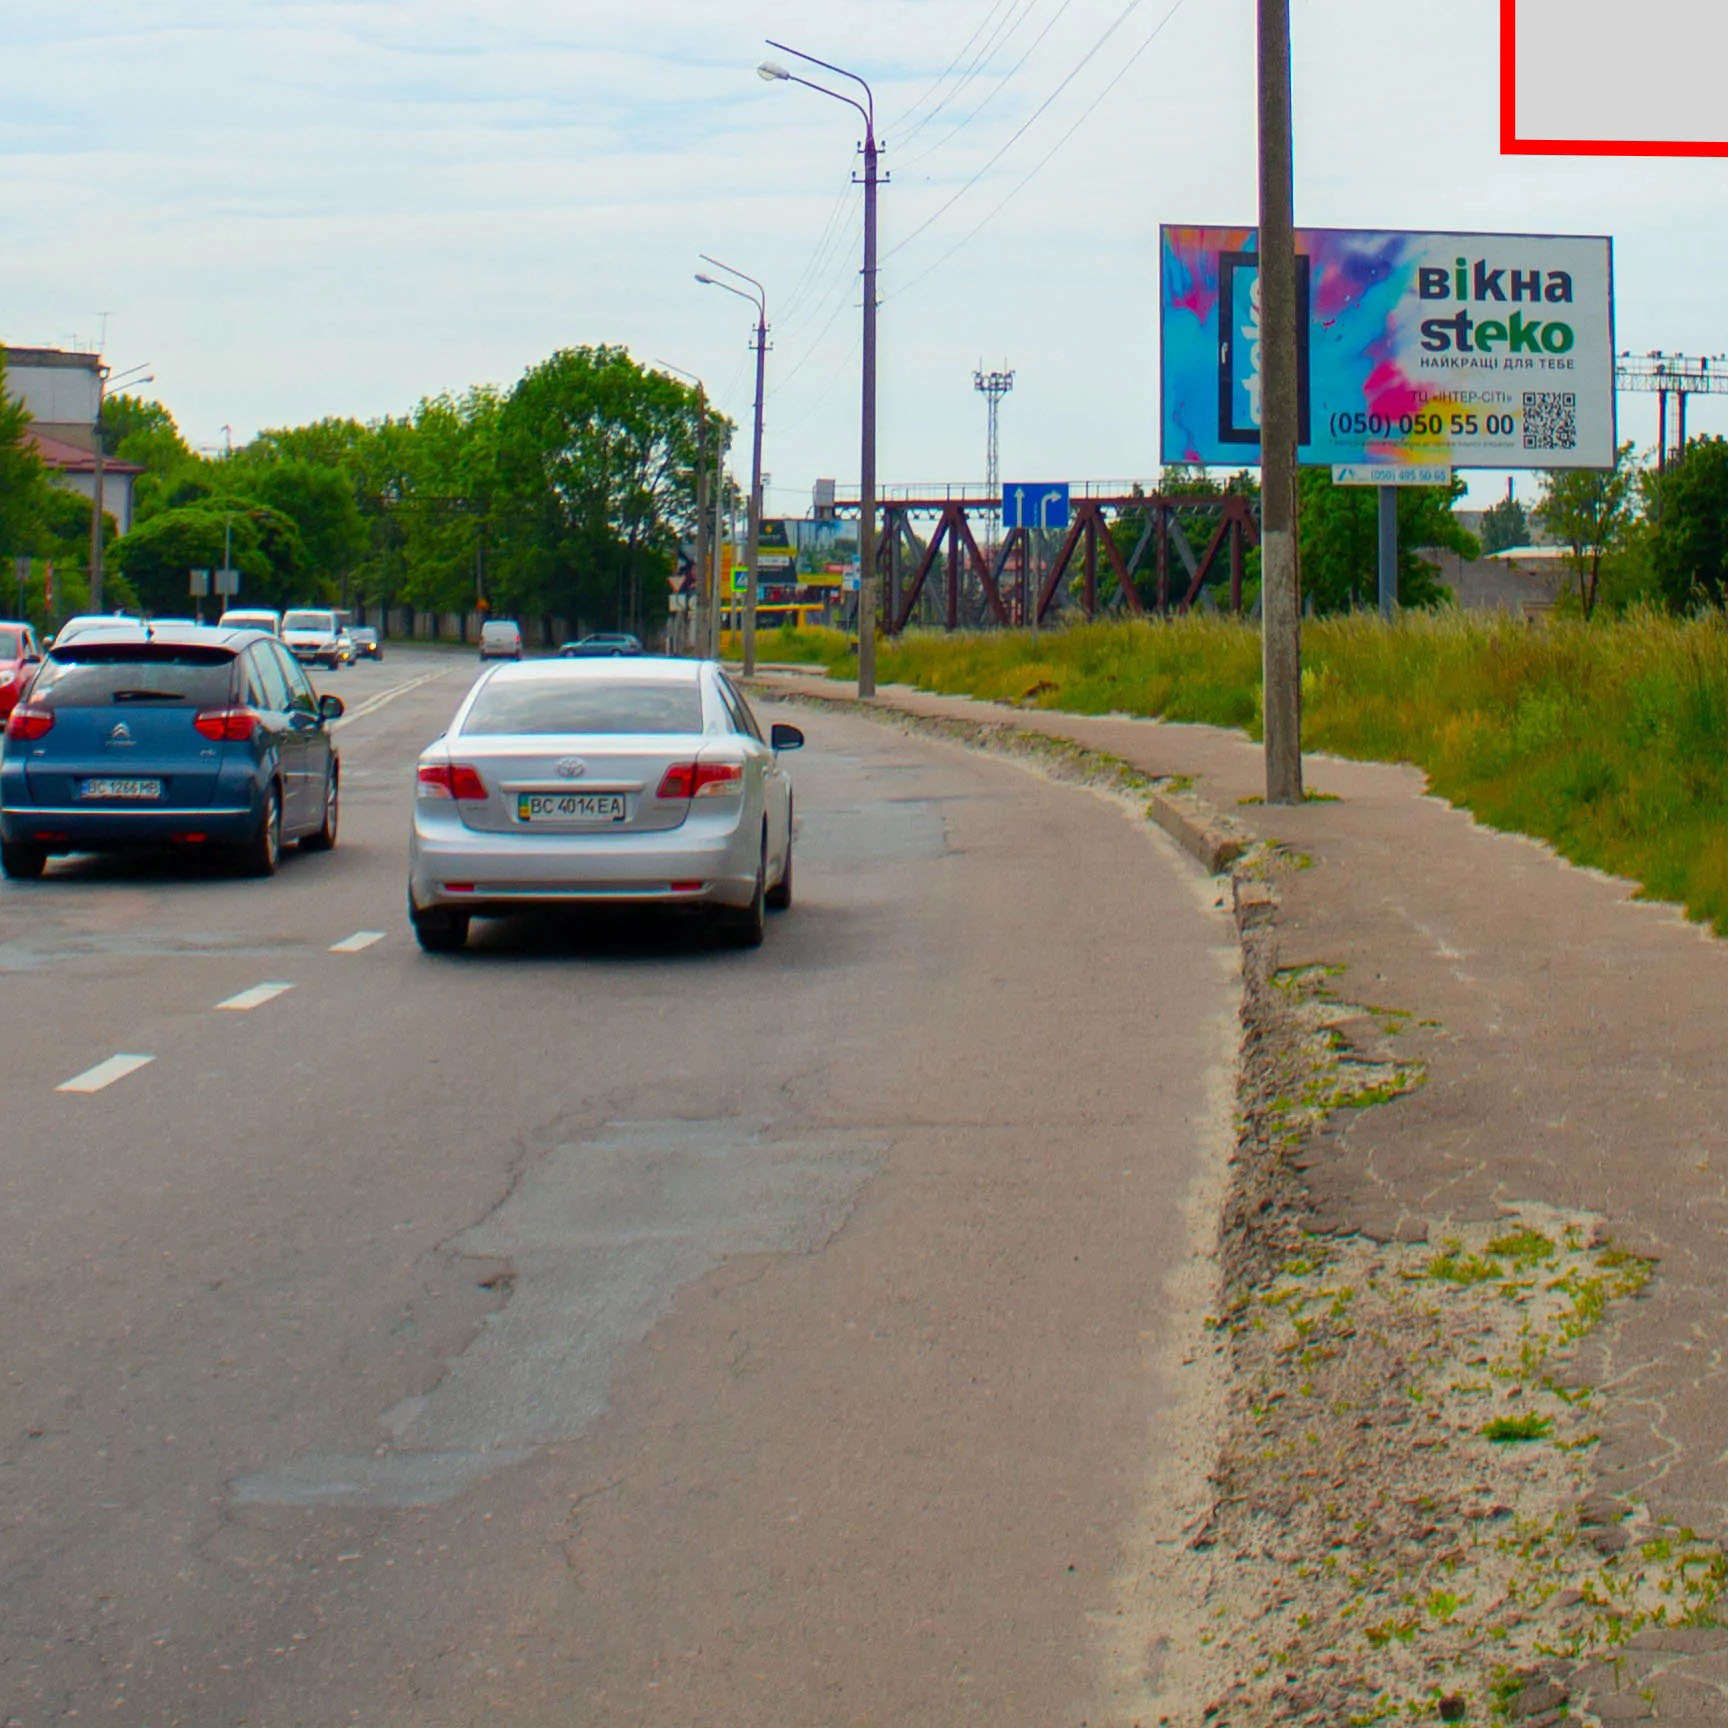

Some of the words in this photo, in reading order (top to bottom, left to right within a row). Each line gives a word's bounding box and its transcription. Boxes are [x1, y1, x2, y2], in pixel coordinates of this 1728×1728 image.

[1418, 257, 1573, 303] вікна
[1420, 308, 1574, 354] steko
[1420, 356, 1498, 370] НАЙКРАЩІ
[1503, 358, 1533, 370] ДЛЯ
[1540, 358, 1575, 370] ТЕБЕ
[1411, 391, 1428, 404] ТЦ
[1329, 413, 1391, 438] (050)
[1399, 414, 1442, 435] 050
[1450, 414, 1478, 435] 55
[1486, 414, 1514, 435] 00
[531, 798, 554, 814] BC
[558, 798, 595, 814] 4014
[598, 797, 621, 813] EA
